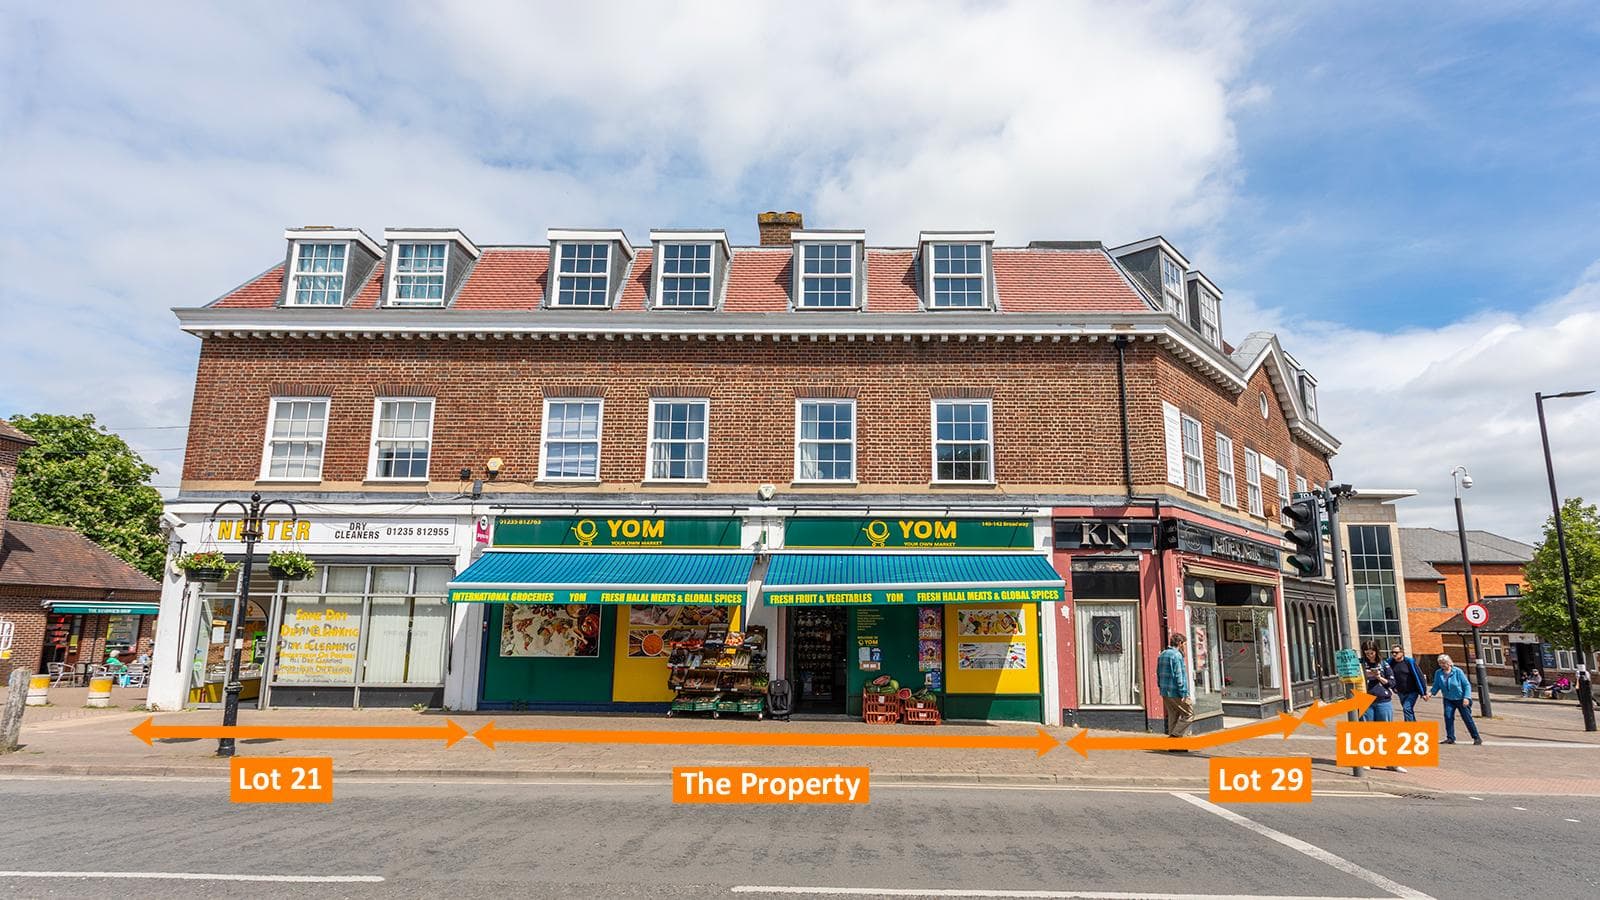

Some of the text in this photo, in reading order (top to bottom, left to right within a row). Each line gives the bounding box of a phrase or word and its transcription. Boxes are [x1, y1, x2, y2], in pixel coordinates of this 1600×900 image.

[217, 519, 311, 540] NETER
[349, 522, 368, 531] DRY
[386, 527, 449, 536] 01235 812955
[607, 519, 665, 538] YOM
[898, 521, 957, 539] YOM
[334, 530, 380, 539] CLEANERS
[1080, 523, 1129, 545] KN
[452, 592, 554, 602] INTERNATIONAL GROCERIES
[569, 593, 587, 602] YOM
[600, 593, 625, 602] FRESH
[625, 593, 649, 602] HALAL
[650, 593, 676, 602] MEATS
[684, 594, 713, 603] GLOBAL
[713, 594, 742, 603] SPICES
[770, 593, 872, 604] FRESH FRUIT & VEGETABLES
[886, 593, 904, 602] YOM
[917, 590, 1060, 602] FRESH HALAL MEATS & GLOBAL SPICES
[1472, 610, 1480, 619] 5
